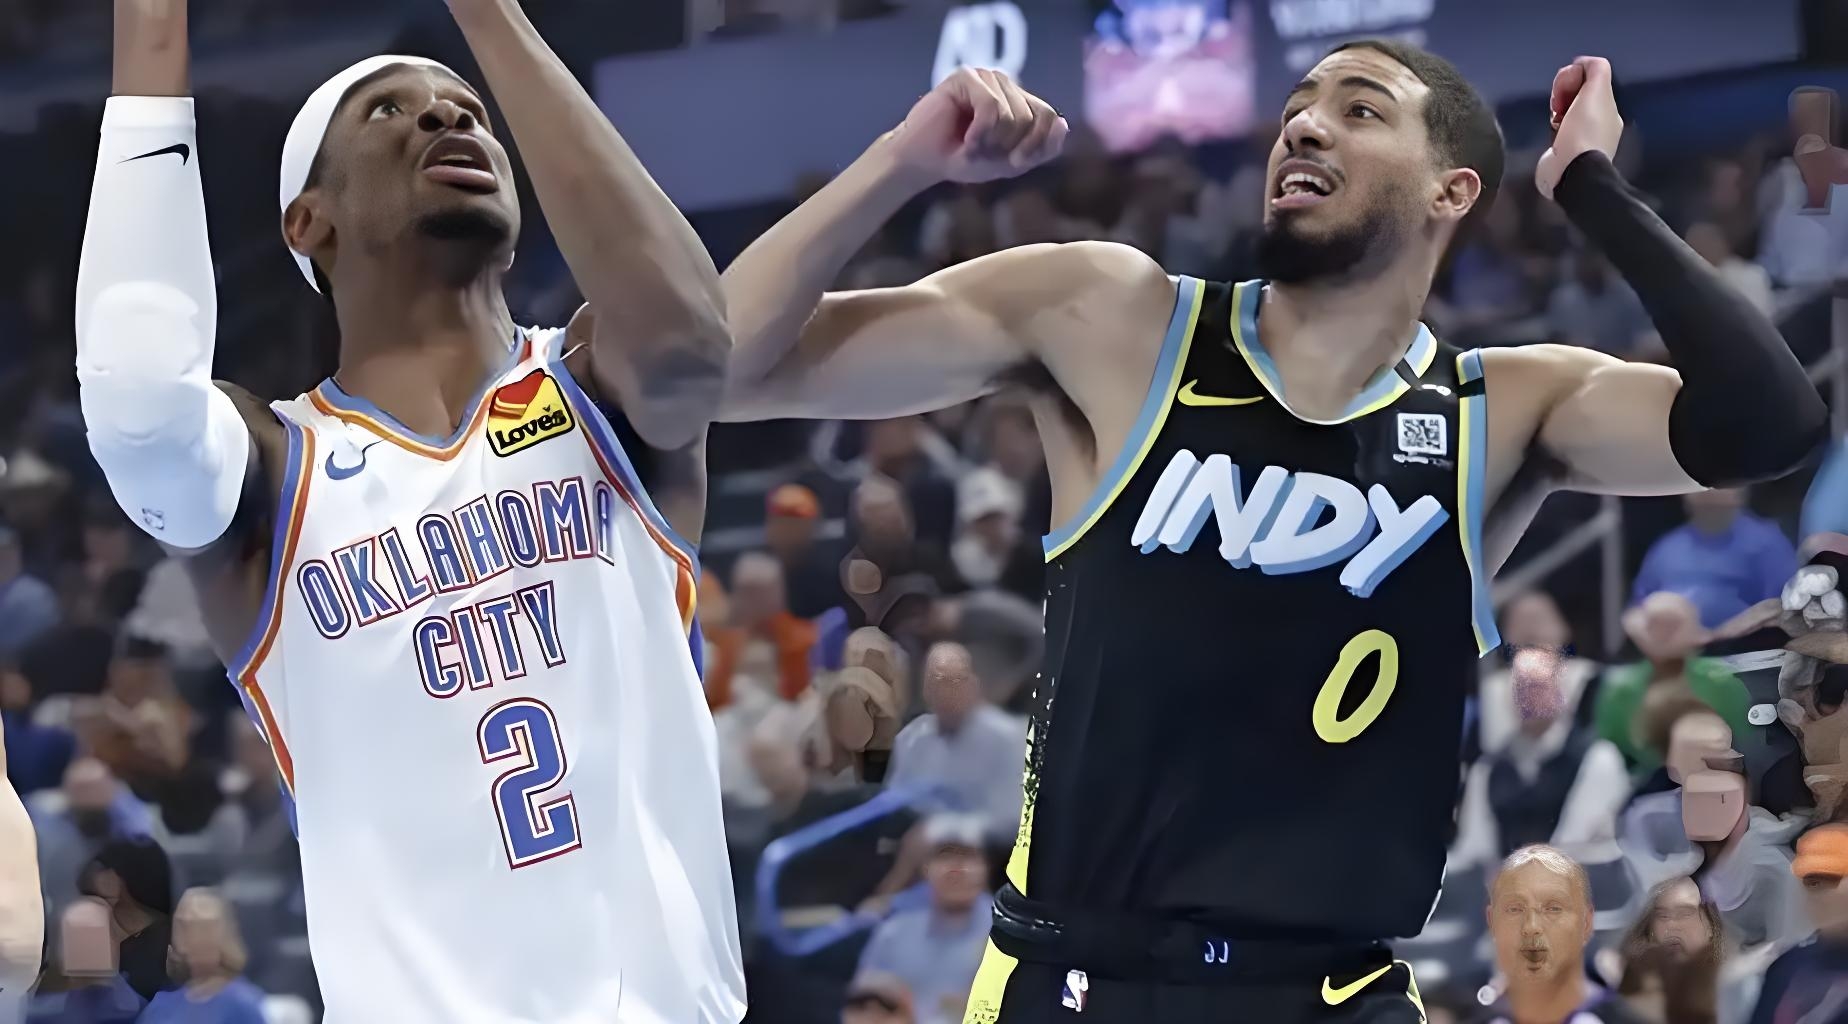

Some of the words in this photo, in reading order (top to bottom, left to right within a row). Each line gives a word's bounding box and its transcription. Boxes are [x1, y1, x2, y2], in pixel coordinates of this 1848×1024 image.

[297, 476, 615, 639] OKLAHOMA
[1131, 448, 1450, 598] INDY
[413, 581, 566, 698] CITY
[1312, 629, 1398, 743] 0
[476, 697, 582, 870] 2
